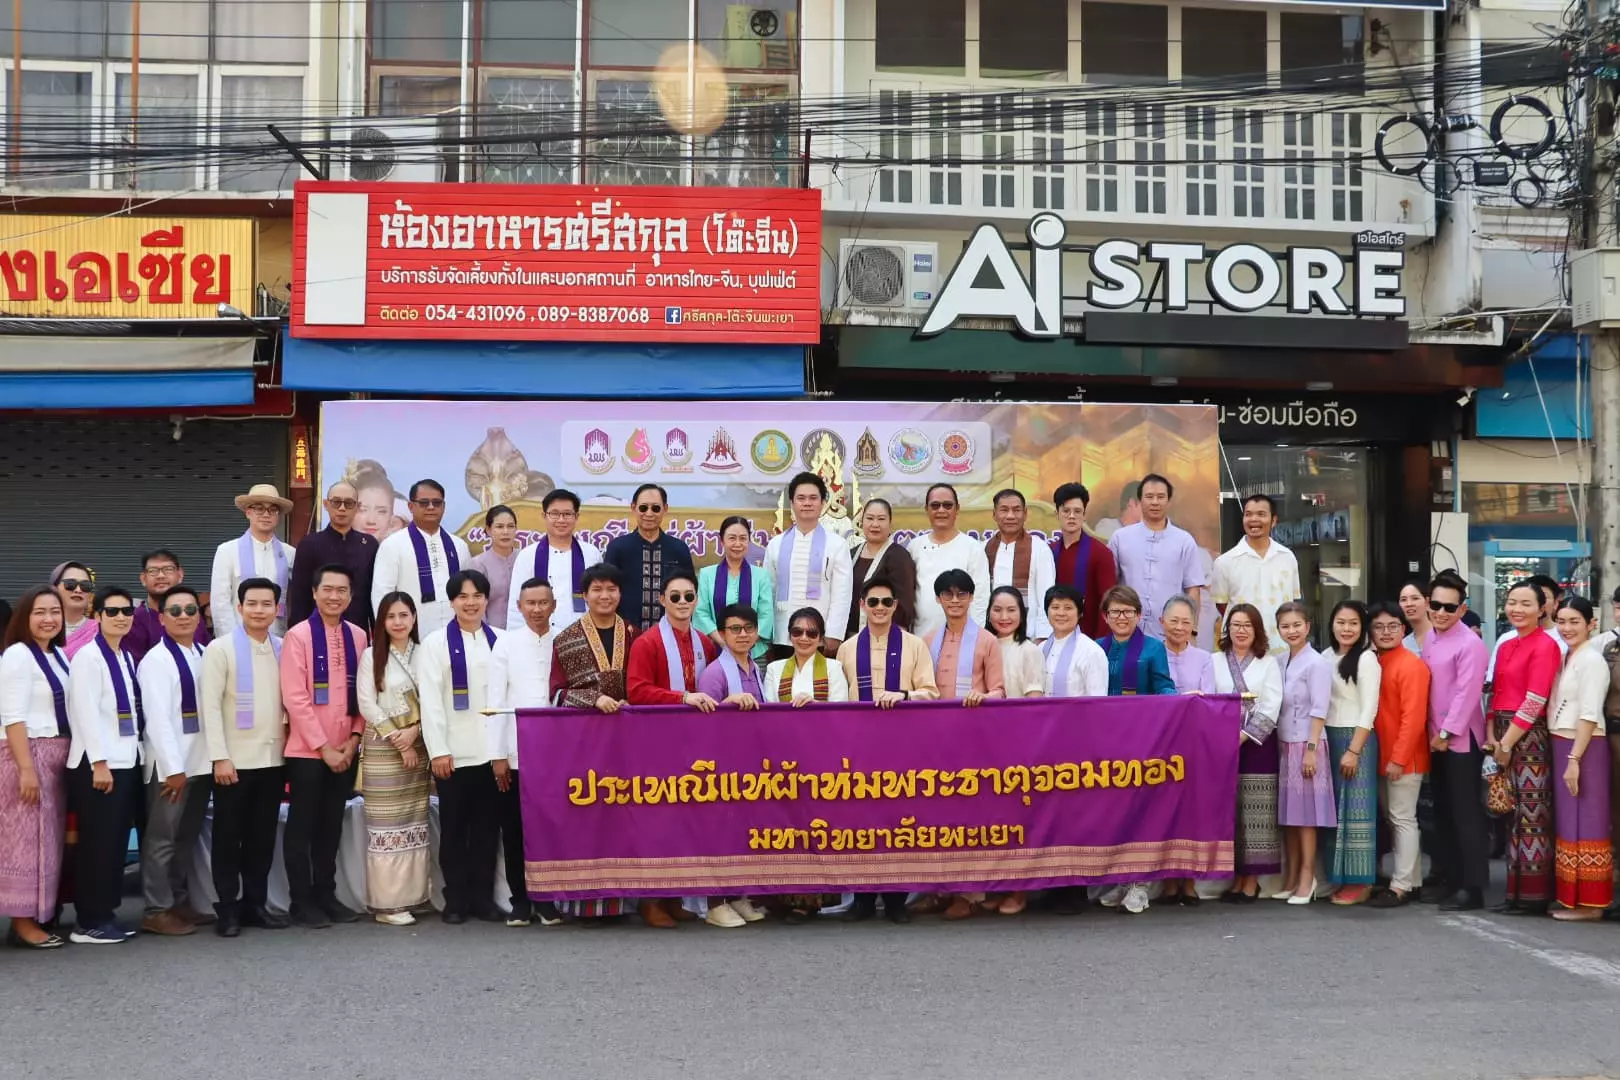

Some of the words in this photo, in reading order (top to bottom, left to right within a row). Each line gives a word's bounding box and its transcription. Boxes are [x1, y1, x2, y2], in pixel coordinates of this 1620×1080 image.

[702, 212, 799, 258] (โต๊ะจีน)
[1357, 231, 1405, 246] เอไอสโตร์
[381, 261, 636, 287] บริการรับจัดเลี้ยงทั้งในและนอกสถานที่
[645, 269, 743, 289] อาหารไทย-จีน,
[1089, 240, 1406, 314] STORE
[380, 305, 419, 321] ติดต่อ
[568, 754, 1186, 807] ประเพณีแห่ผ้าห่มพระธาตุจอมทอง
[748, 816, 1025, 850] มหาวิทยาลัยพะเยา
